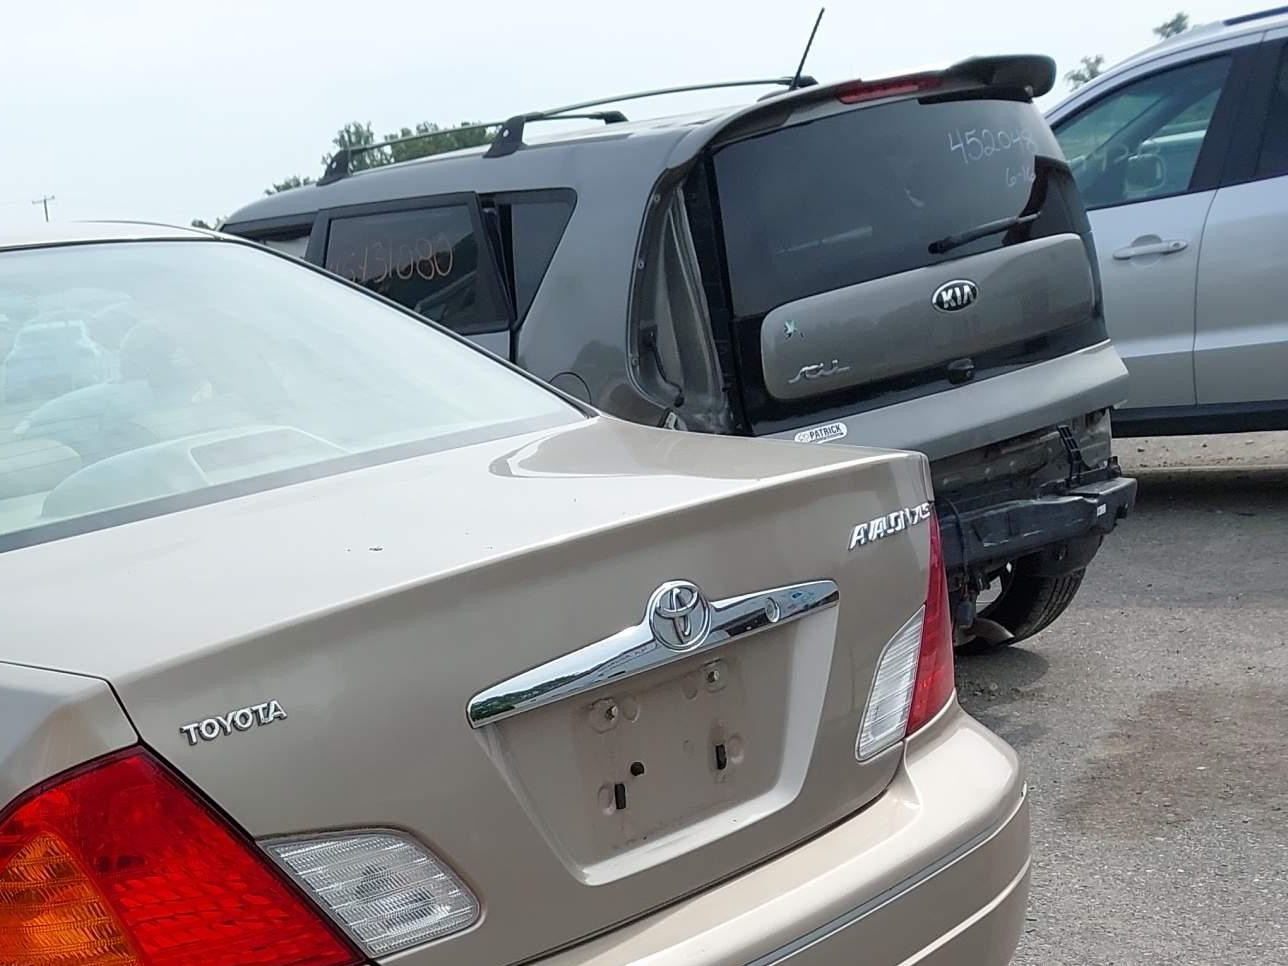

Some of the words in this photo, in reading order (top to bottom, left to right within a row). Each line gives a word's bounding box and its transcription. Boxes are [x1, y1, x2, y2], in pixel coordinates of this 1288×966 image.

[941, 284, 973, 309] KIA
[809, 423, 842, 440] PATRICK
[179, 699, 288, 746] TOYOTA
